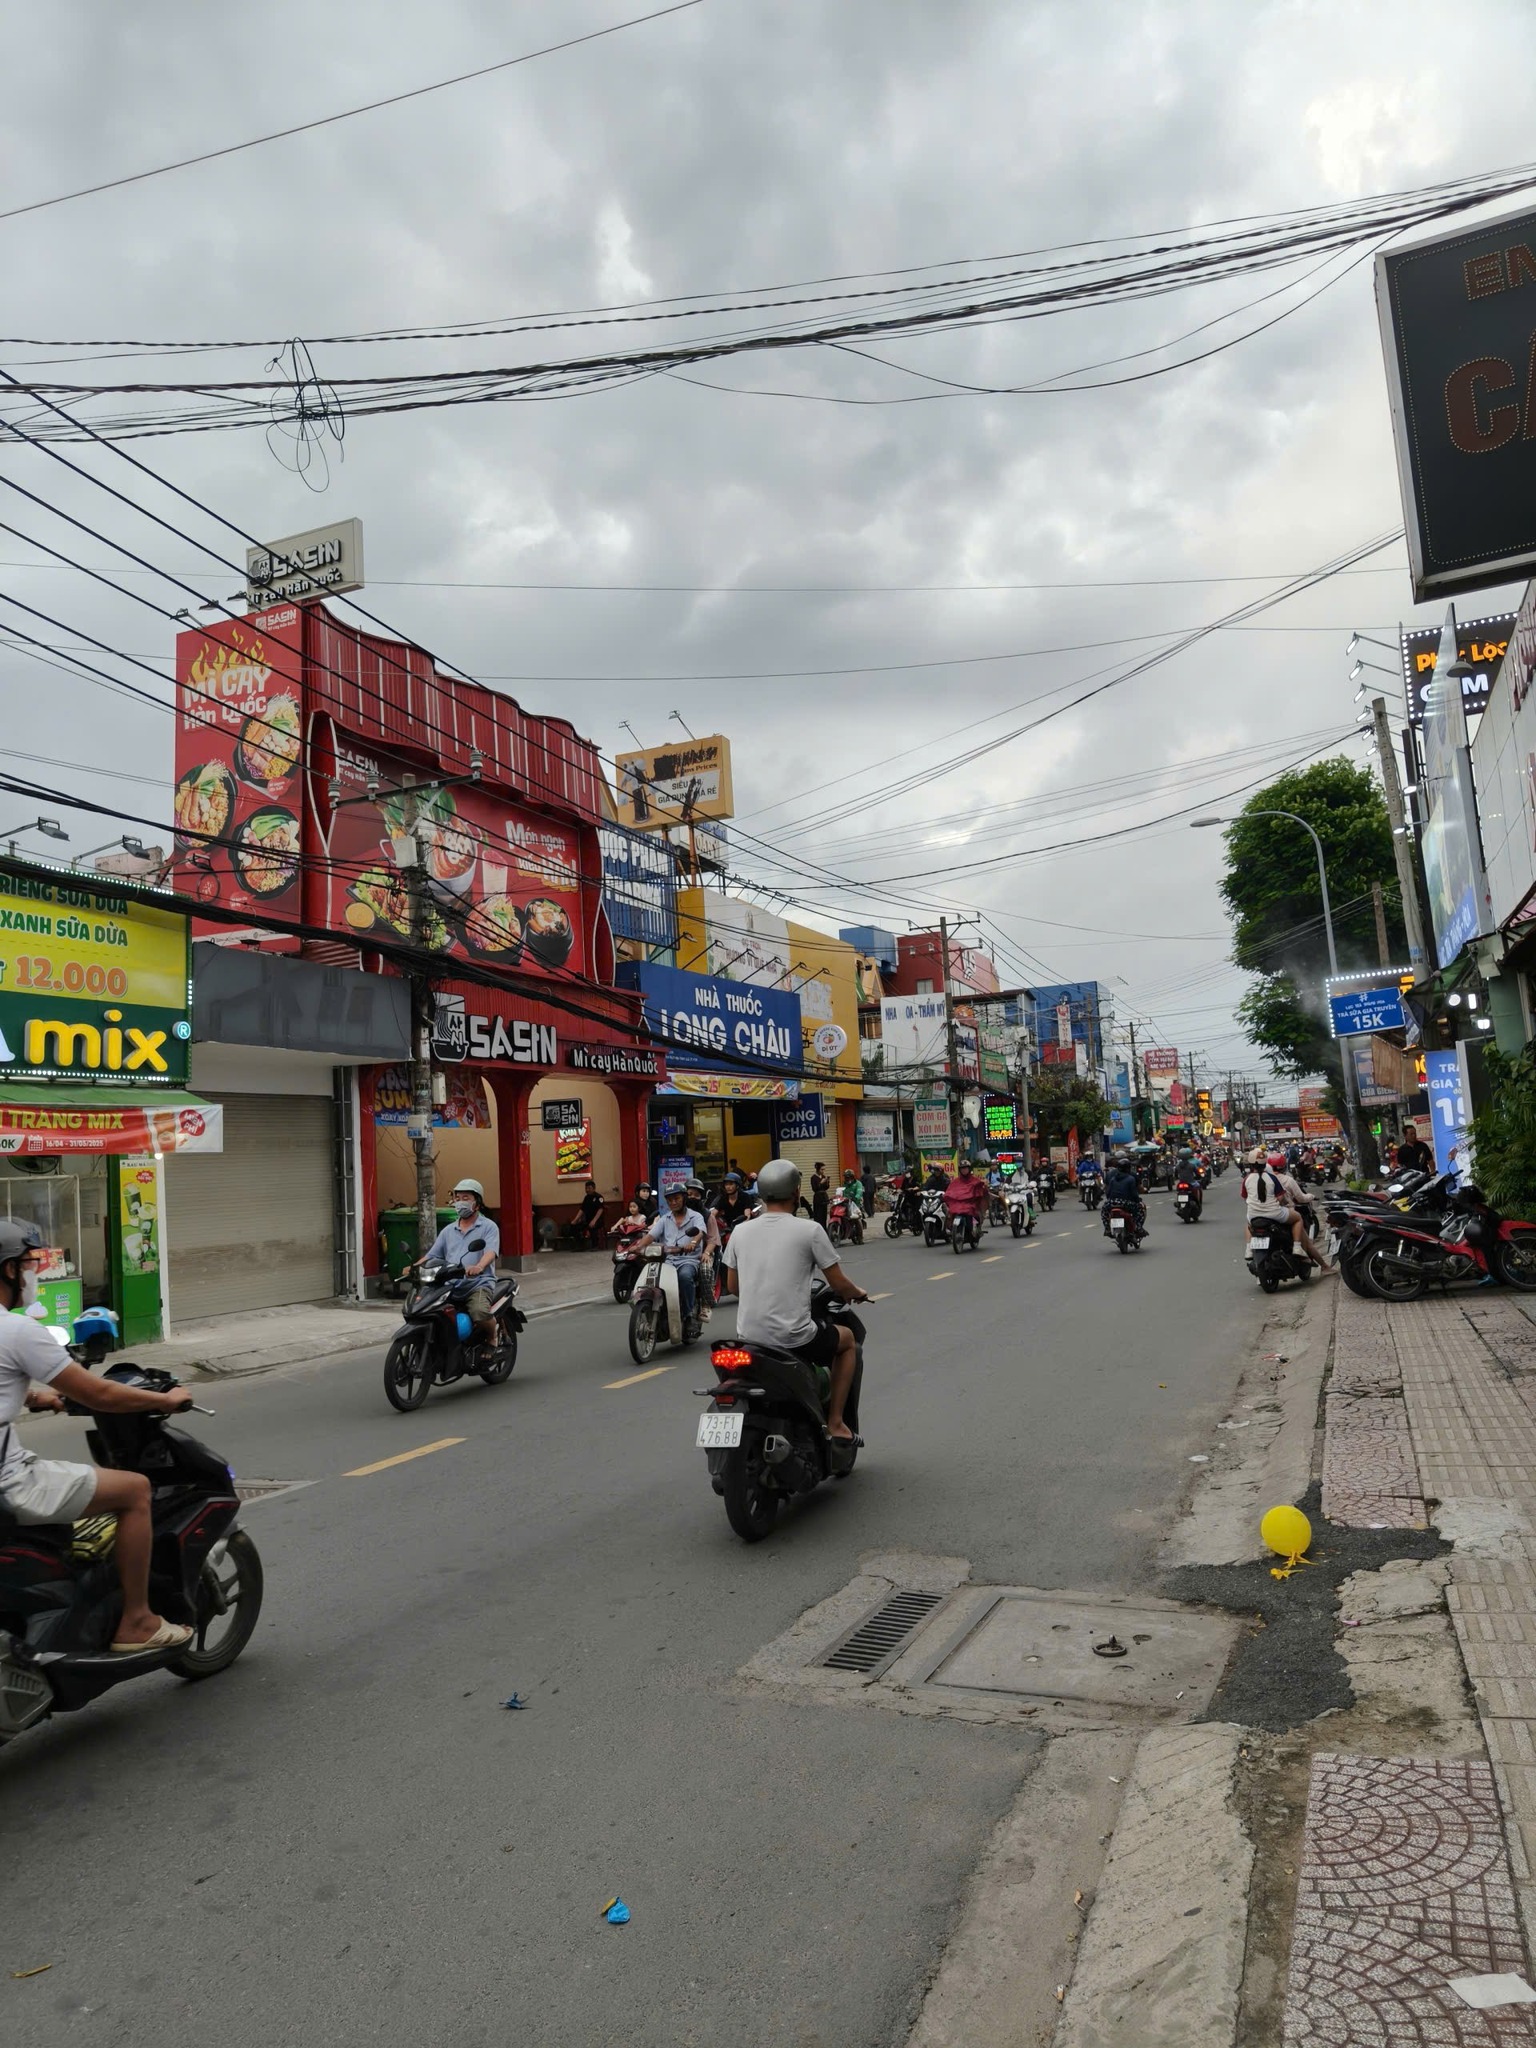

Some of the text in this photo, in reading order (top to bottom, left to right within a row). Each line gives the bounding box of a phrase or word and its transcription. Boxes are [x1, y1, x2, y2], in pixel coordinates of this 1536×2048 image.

[273, 538, 341, 578] SASIN
[268, 609, 297, 626] SASIN
[221, 665, 272, 697] CAY
[696, 763, 718, 772] Prices
[658, 795, 671, 804] GIA
[505, 820, 539, 850] Món
[0, 909, 128, 947] XANH SỮA DỪA
[16, 955, 129, 998] 12.000
[695, 985, 763, 1017] NHÀ THUỐC
[1362, 1006, 1373, 1014] GIA
[1352, 1012, 1385, 1030] 15K
[25, 1009, 168, 1072] mix
[470, 1015, 557, 1065] SASIN
[735, 1018, 791, 1060] CHÂU
[573, 1046, 589, 1068] Mì
[590, 1054, 611, 1073] cay
[612, 1050, 634, 1073] Hàn
[634, 1052, 659, 1074] Quốc
[1431, 1079, 1453, 1089] GIA
[561, 1104, 576, 1115] SA
[780, 1109, 816, 1123] LONG
[87, 1113, 125, 1130] MIX
[561, 1114, 578, 1125] SIN
[780, 1124, 818, 1139] CHÂU
[45, 1139, 63, 1149] 16/04
[706, 1416, 736, 1430] 73-F1
